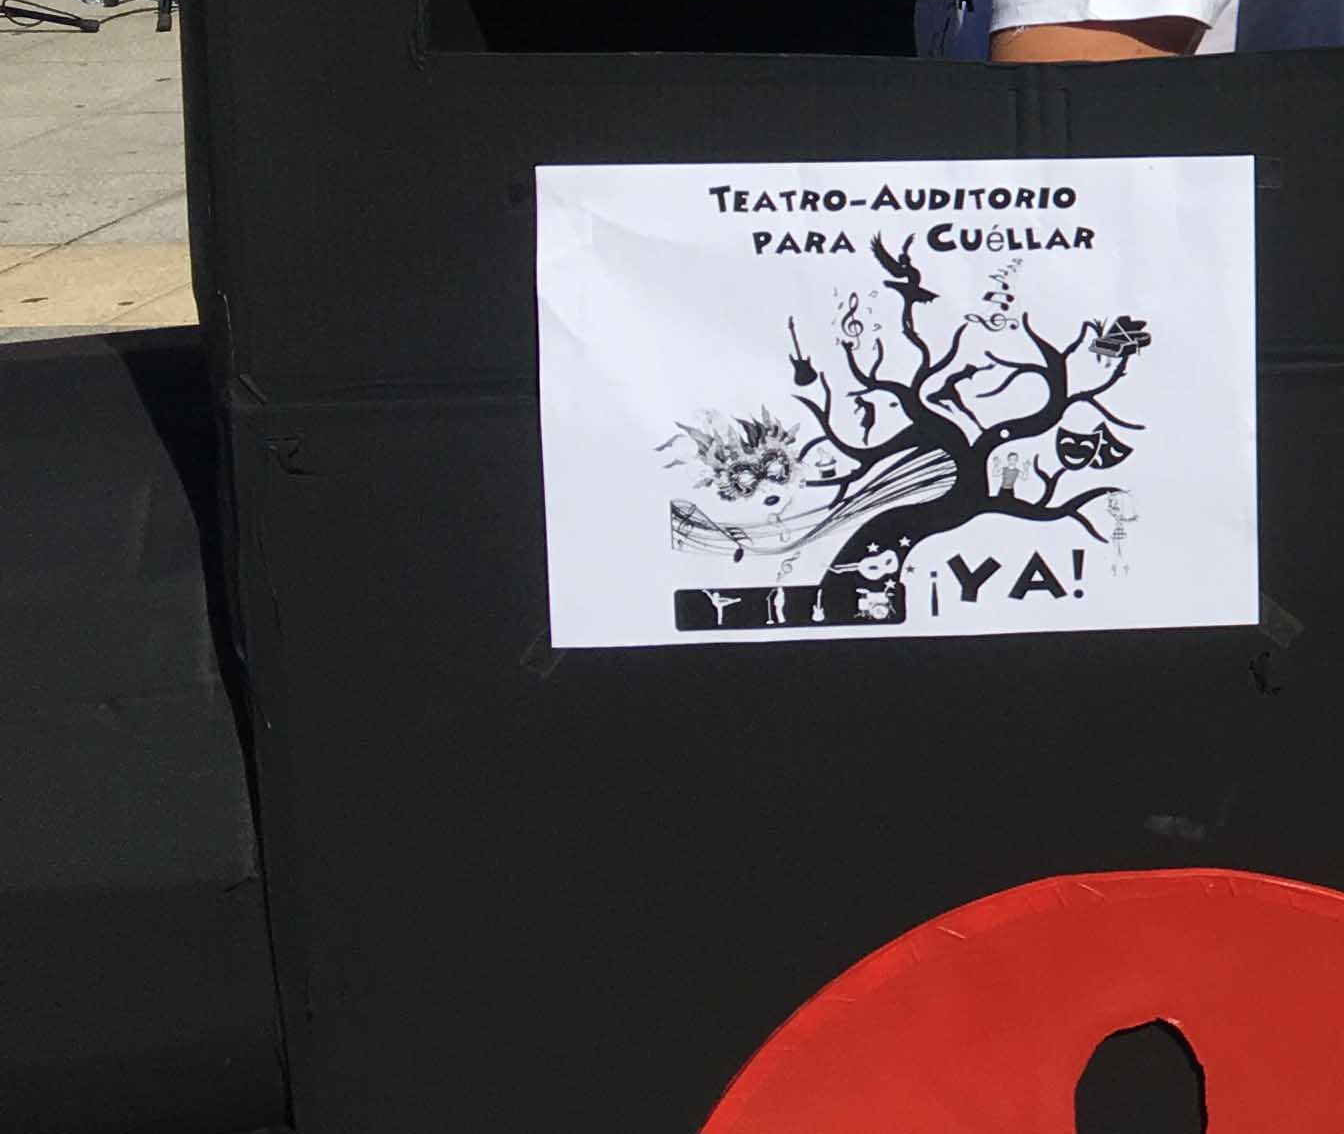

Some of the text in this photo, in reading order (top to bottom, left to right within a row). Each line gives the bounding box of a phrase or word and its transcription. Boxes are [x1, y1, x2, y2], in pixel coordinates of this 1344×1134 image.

[708, 185, 1077, 213] TEATRO-AUDITORIO
[752, 230, 856, 255] PARA
[930, 549, 1086, 617] ¡YA!
